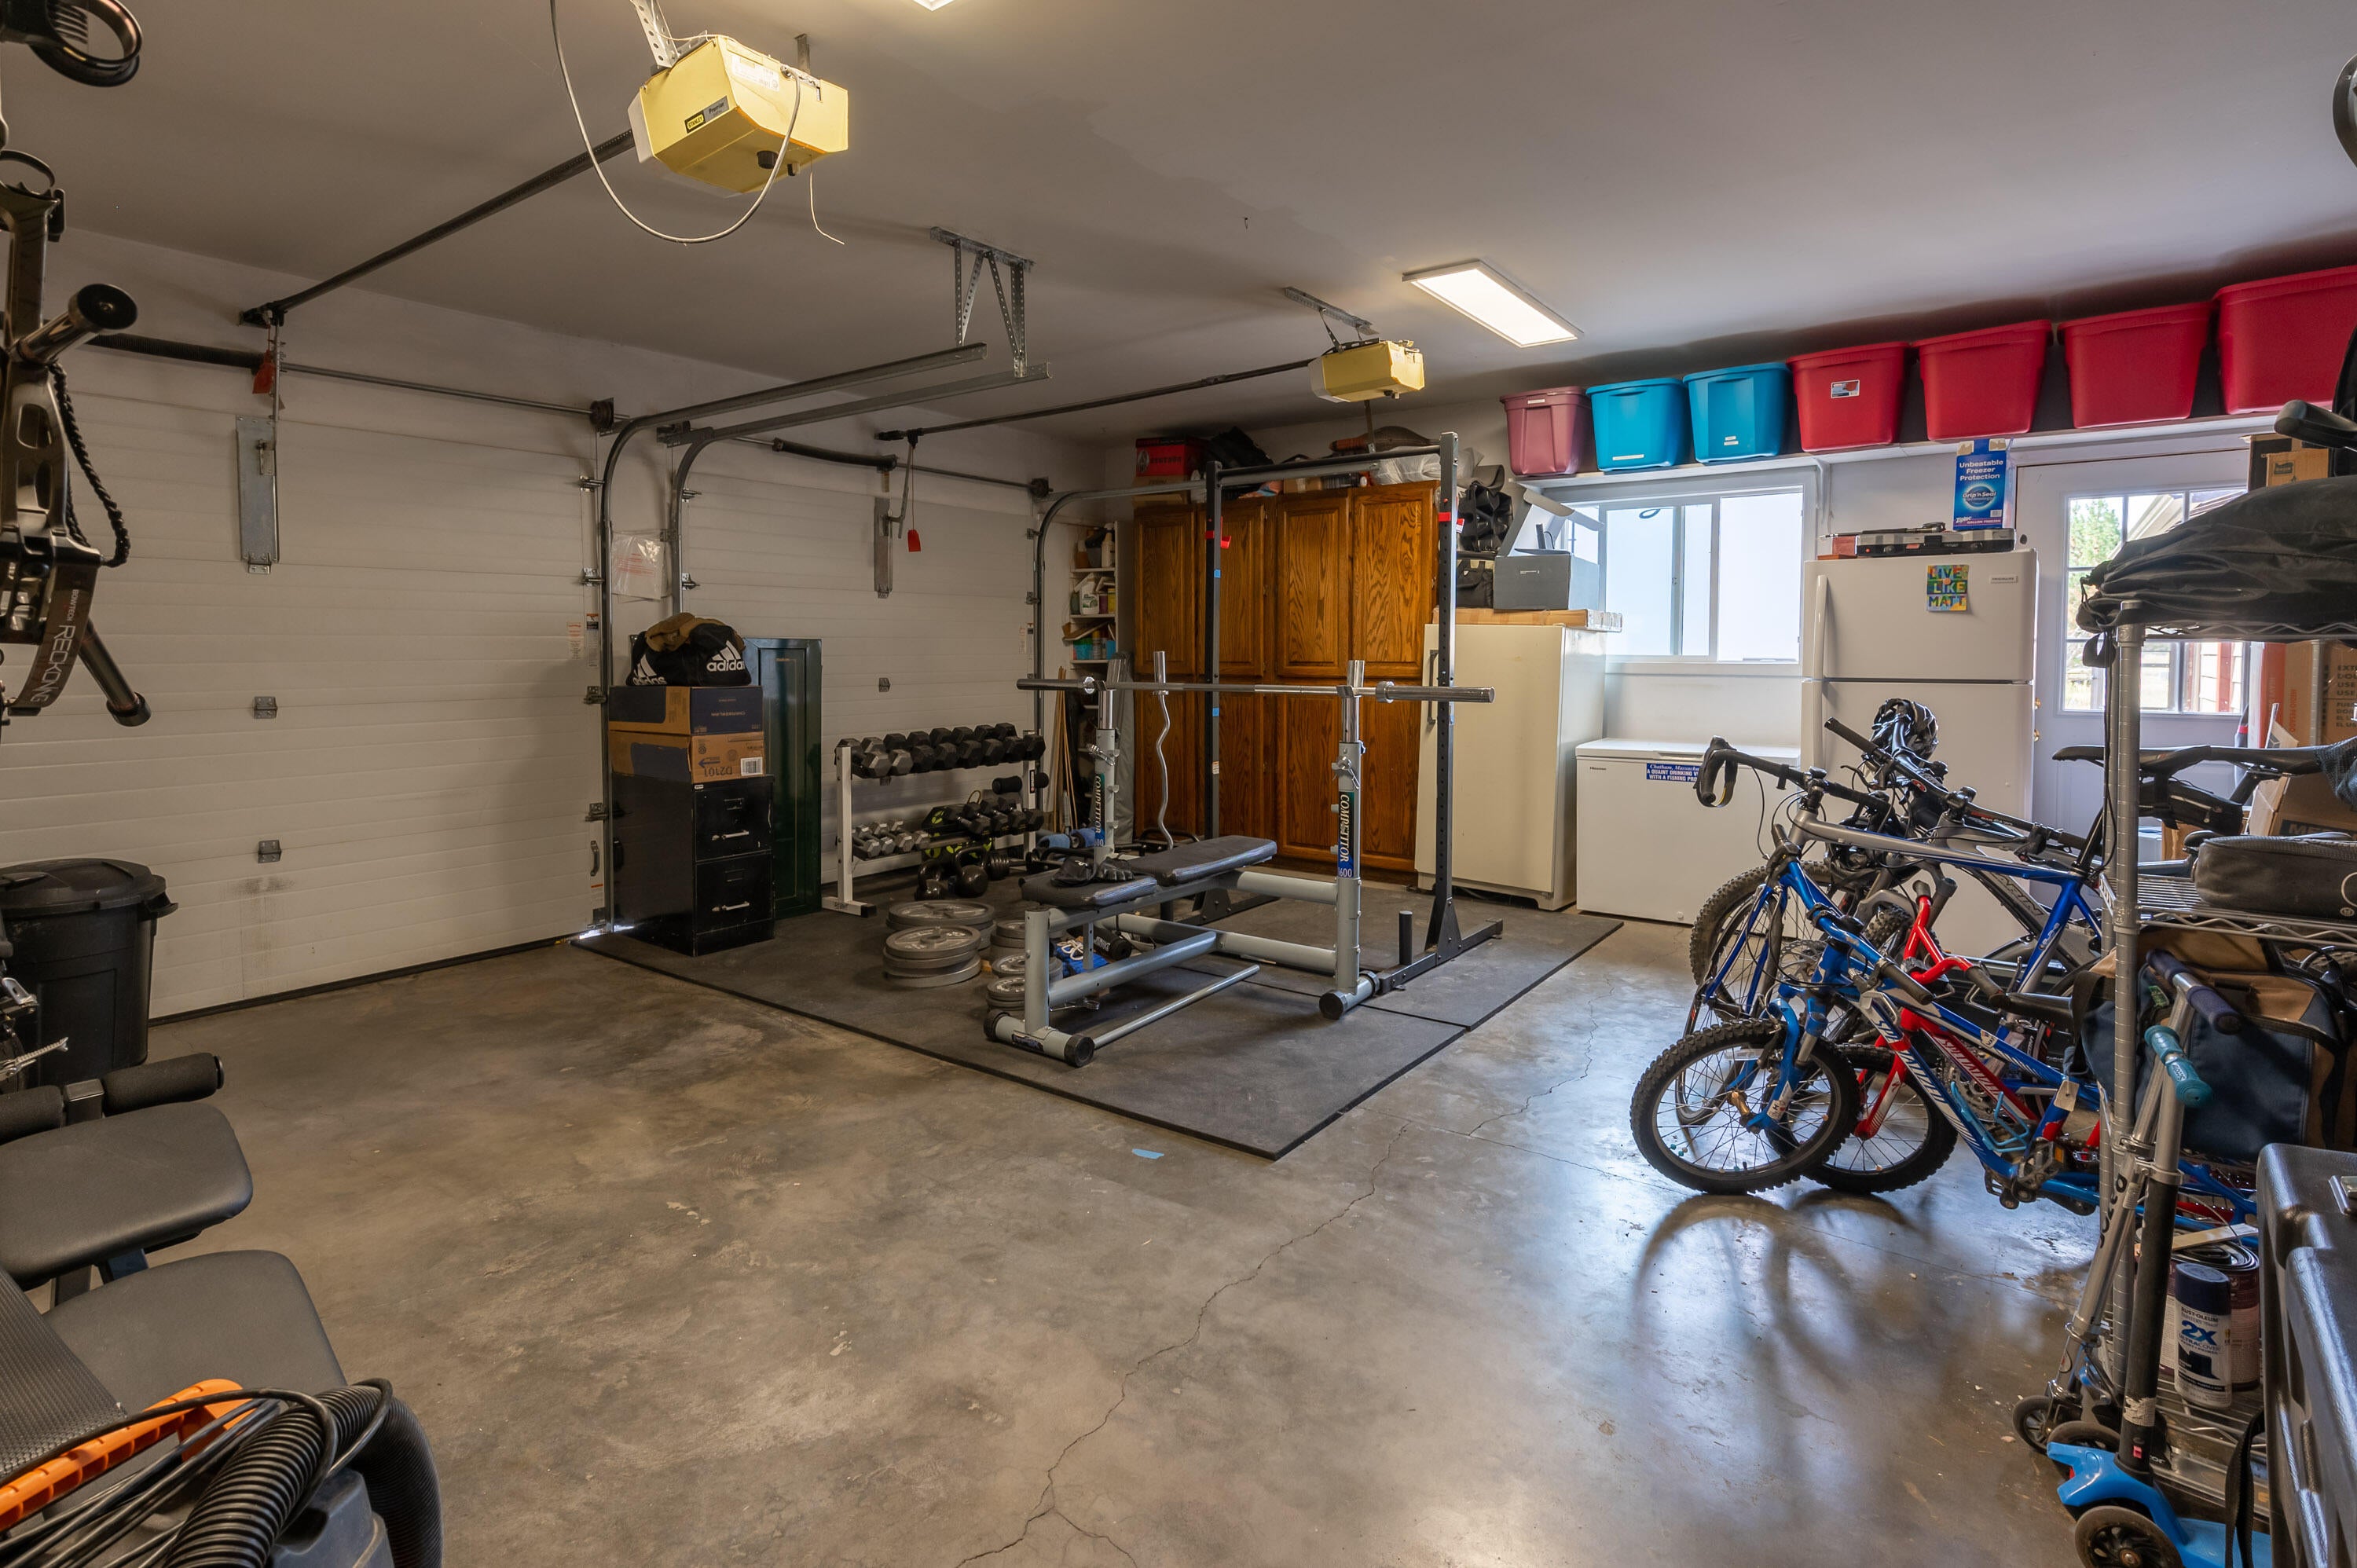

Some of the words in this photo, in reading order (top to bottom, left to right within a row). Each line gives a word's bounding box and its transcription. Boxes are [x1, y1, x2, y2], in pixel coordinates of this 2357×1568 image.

[688, 115, 703, 128] STANLEY
[1959, 460, 2003, 468] Unbeatable
[1929, 567, 1963, 580] LIVE
[1934, 581, 1966, 594] LIKE
[1928, 595, 1966, 607] MATT
[1340, 794, 1350, 862] COMPETITOR
[2181, 1306, 2219, 1322] RUST-OLEUM
[2181, 1320, 2218, 1346] 2X
